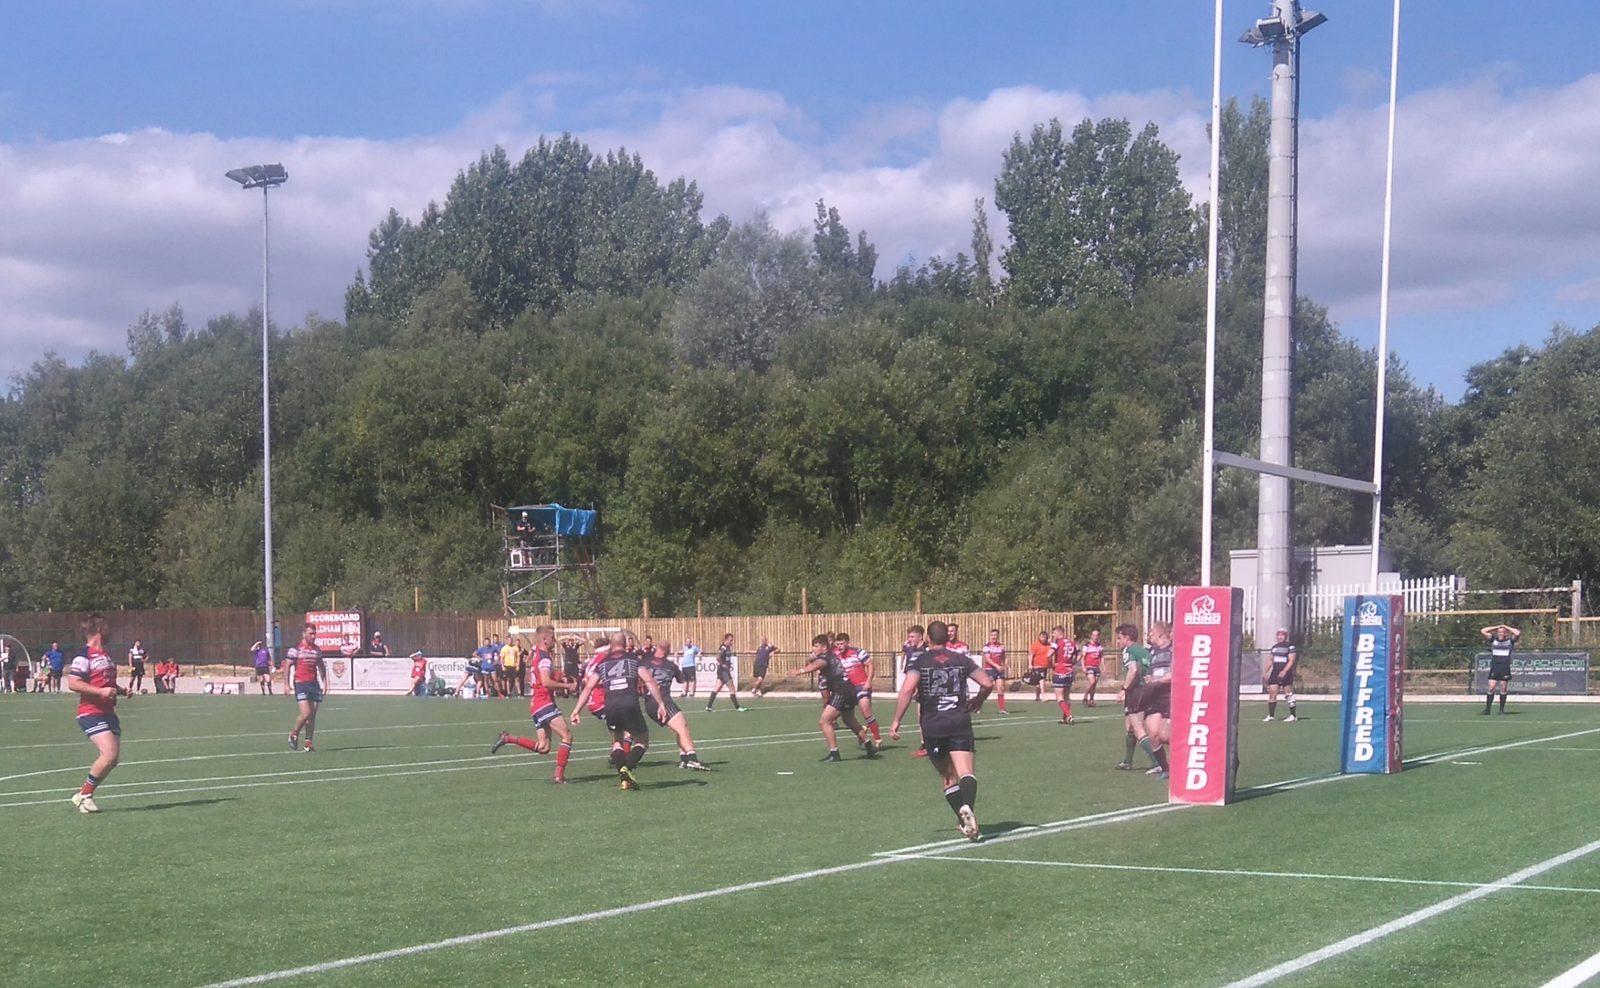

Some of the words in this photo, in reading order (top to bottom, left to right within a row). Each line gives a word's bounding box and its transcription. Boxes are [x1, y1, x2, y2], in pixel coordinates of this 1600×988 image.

[309, 613, 360, 622] SCOREBOARD
[1185, 613, 1220, 623] RHINO
[315, 624, 341, 633] LDHAM
[607, 659, 626, 678] 4
[931, 668, 961, 694] 21
[1355, 633, 1375, 762] BETFRED
[1186, 634, 1212, 791] BETFRED
